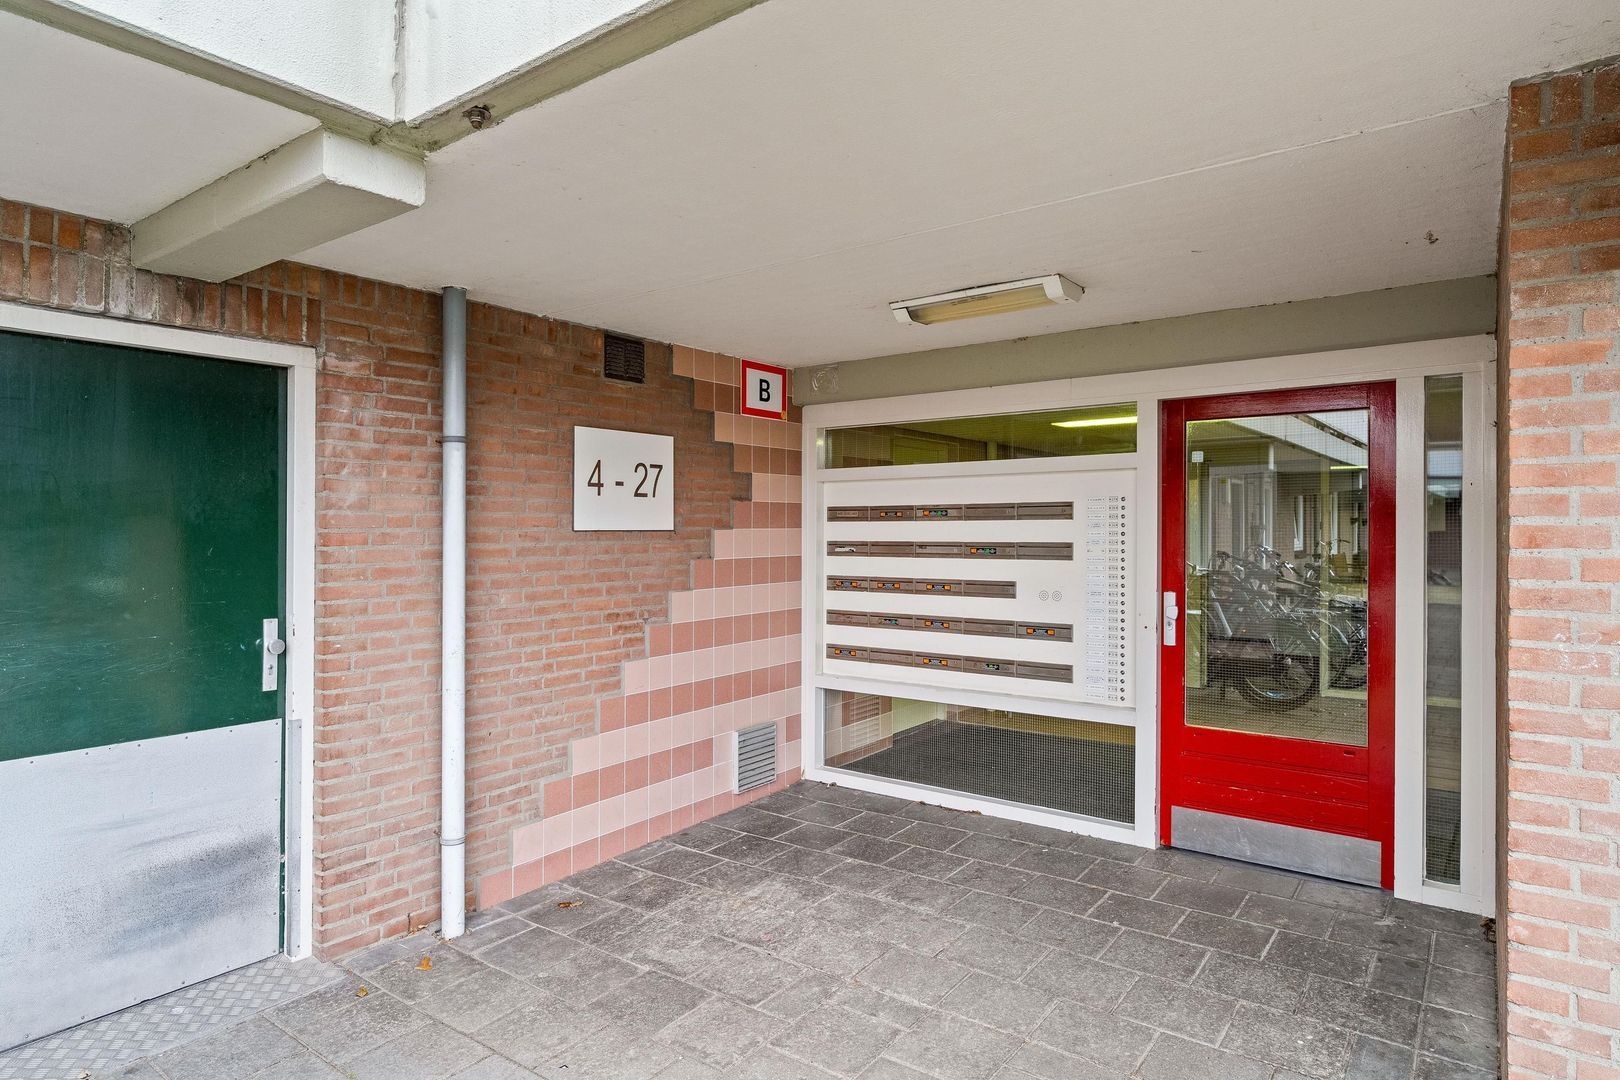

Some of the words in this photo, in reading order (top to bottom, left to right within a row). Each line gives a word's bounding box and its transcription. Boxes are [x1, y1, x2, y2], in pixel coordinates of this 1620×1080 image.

[759, 379, 770, 402] B
[587, 459, 604, 496] 4
[633, 462, 663, 498] 27
